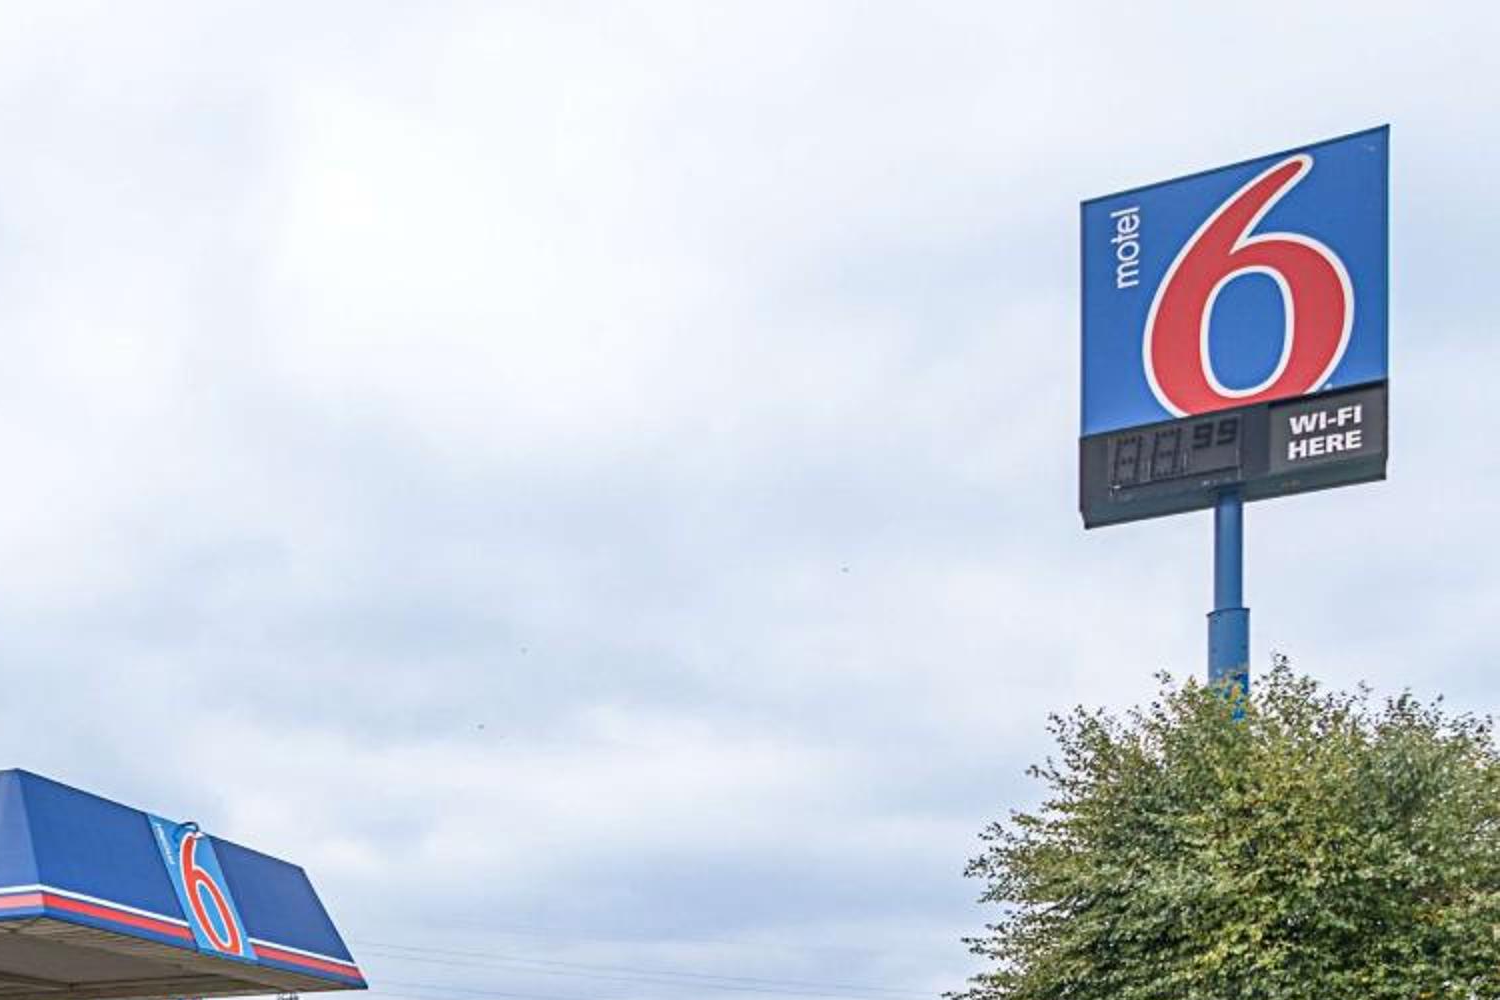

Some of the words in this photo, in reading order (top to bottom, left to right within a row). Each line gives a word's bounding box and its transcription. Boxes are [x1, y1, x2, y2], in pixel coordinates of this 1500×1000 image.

[1110, 207, 1140, 289] motel
[1142, 153, 1355, 418] 6
[1288, 430, 1363, 460] HERE
[1289, 404, 1362, 435] WI-FI
[180, 831, 244, 956] 6
